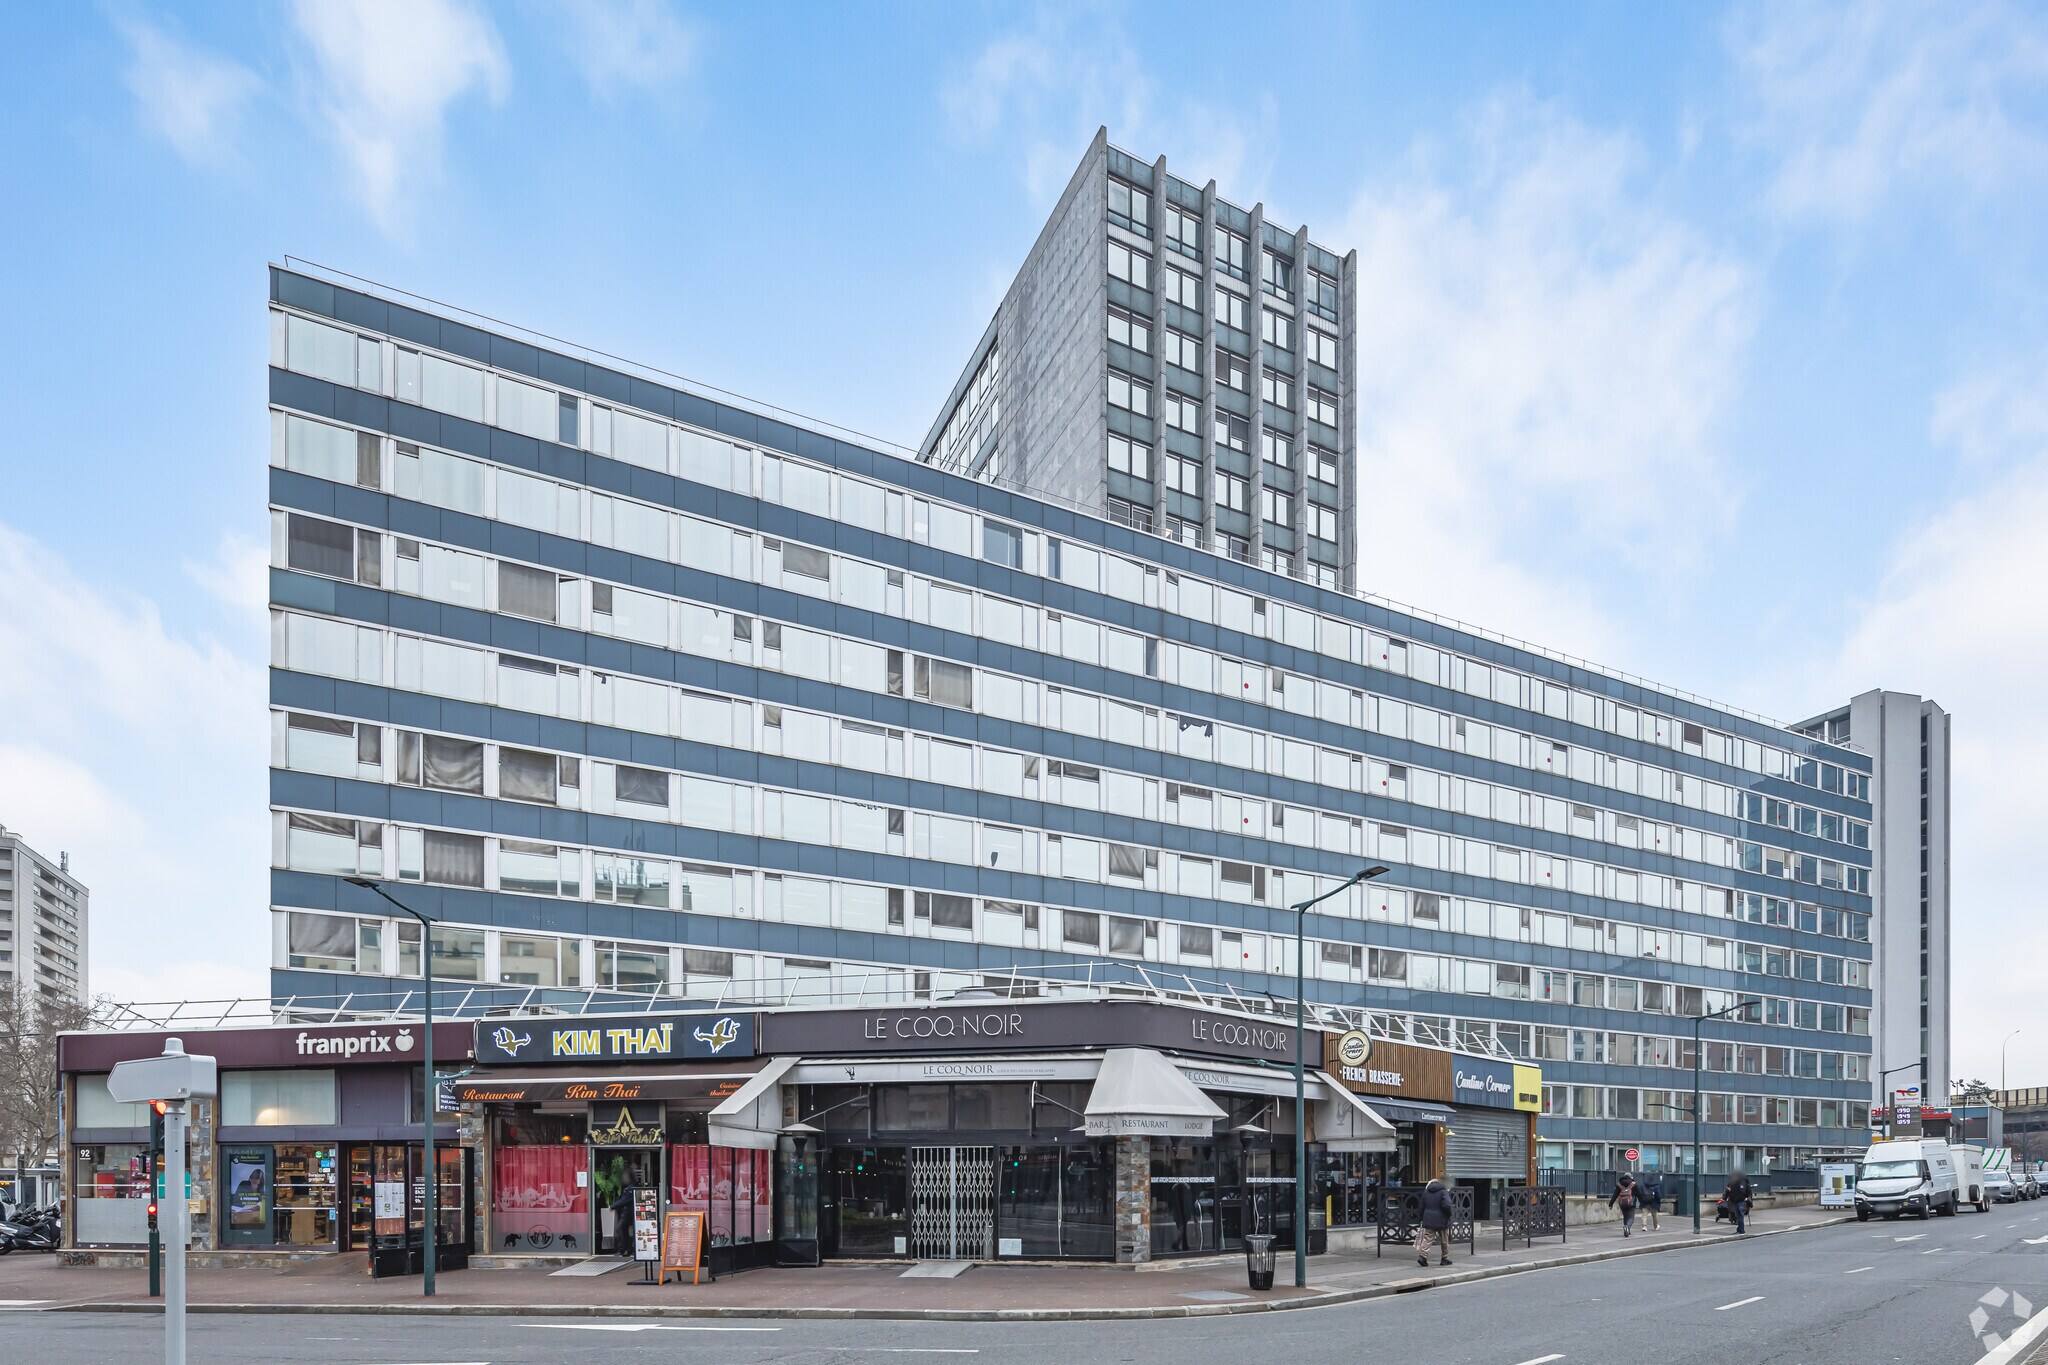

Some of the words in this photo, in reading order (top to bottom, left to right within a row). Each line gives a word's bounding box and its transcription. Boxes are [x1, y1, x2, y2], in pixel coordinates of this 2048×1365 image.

[865, 1018, 887, 1038] LE
[896, 1015, 955, 1038] COQ
[963, 1014, 1023, 1036] NOIR
[552, 1029, 601, 1056] KIM
[606, 1022, 674, 1055] THAÏ
[1192, 1018, 1207, 1039] LE
[1213, 1022, 1249, 1046] COQ
[1252, 1028, 1287, 1051] NOIR
[296, 1030, 391, 1059] franprix
[1341, 1048, 1363, 1056] Corner
[923, 1066, 934, 1075] LE
[937, 1065, 964, 1076] COQ
[965, 1064, 994, 1074] NOIR
[1194, 1072, 1212, 1084] COQ
[1212, 1075, 1230, 1084] NOIR
[1342, 1066, 1367, 1082] FRENCH
[1369, 1070, 1401, 1087] BRASSERIE
[1455, 1070, 1485, 1091] Cantine
[1485, 1075, 1511, 1094] Corner
[463, 1089, 525, 1100] Restaurant
[565, 1084, 598, 1099] Kim
[603, 1083, 641, 1098] Thaï
[1121, 1119, 1169, 1129] RESTAURANT
[1184, 1122, 1204, 1130] LODGE
[596, 1133, 621, 1144] KIM
[80, 1149, 91, 1158] 92
